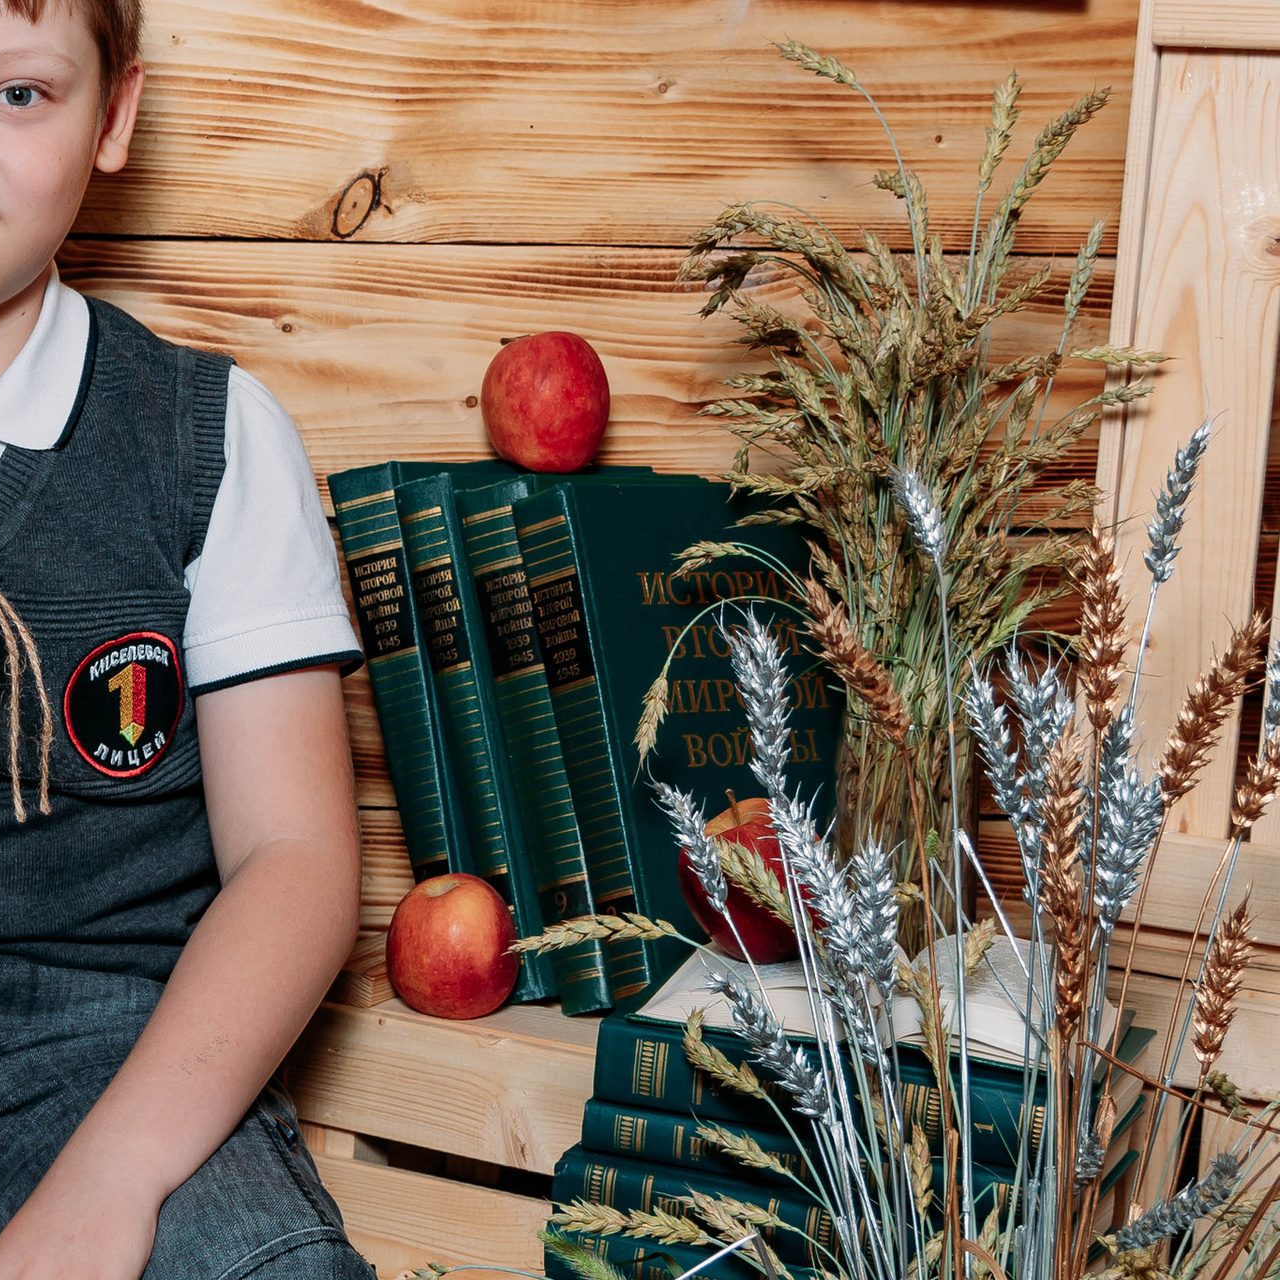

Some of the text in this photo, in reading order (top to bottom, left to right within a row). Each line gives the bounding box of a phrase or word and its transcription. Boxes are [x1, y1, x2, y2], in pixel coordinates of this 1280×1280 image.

[354, 556, 398, 578] ИСТОРИЯ
[360, 571, 397, 592] ВТОРОЙ
[532, 580, 574, 605] ИСТОРИЯ
[358, 585, 405, 608] МИРОВОЙ
[421, 584, 454, 604] ТОРОЙ
[366, 602, 401, 621] ВОЙНЫ
[538, 596, 574, 618] ВТОРОЙ
[375, 620, 398, 635] 1939
[545, 628, 579, 649] ВОЙНЫ
[661, 617, 804, 659] ВТОЙ
[377, 635, 401, 651] 1945
[89, 644, 170, 681] КИСЕЛЕВСК
[553, 647, 577, 665] 1939
[108, 662, 147, 747] 1
[93, 731, 167, 767] ЛИЦЕЙ
[681, 726, 822, 769] ВОЙЫ
[553, 890, 568, 915] 9
